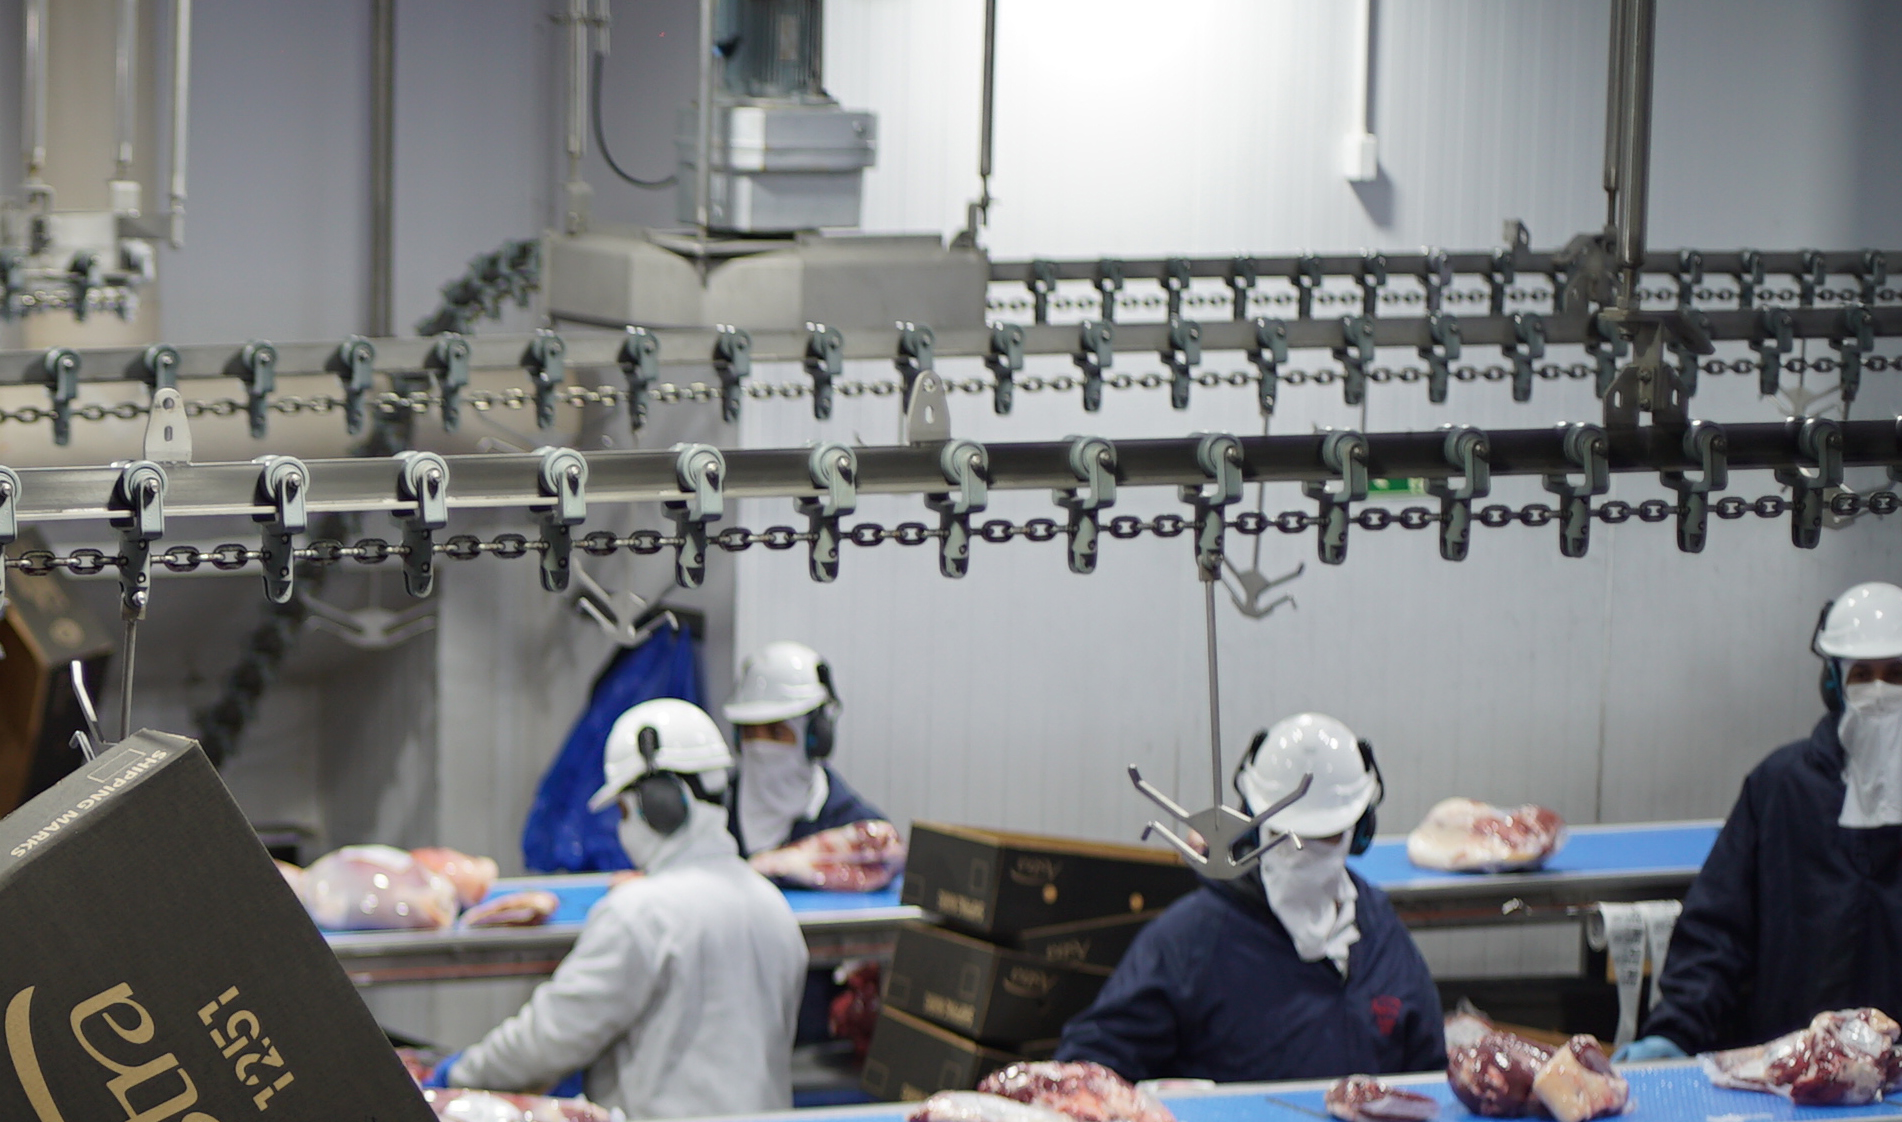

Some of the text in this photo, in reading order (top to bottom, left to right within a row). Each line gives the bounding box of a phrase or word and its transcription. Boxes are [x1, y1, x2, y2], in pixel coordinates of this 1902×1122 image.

[10, 749, 167, 859] SHIPPING MARKS
[197, 985, 295, 1112] 1251
